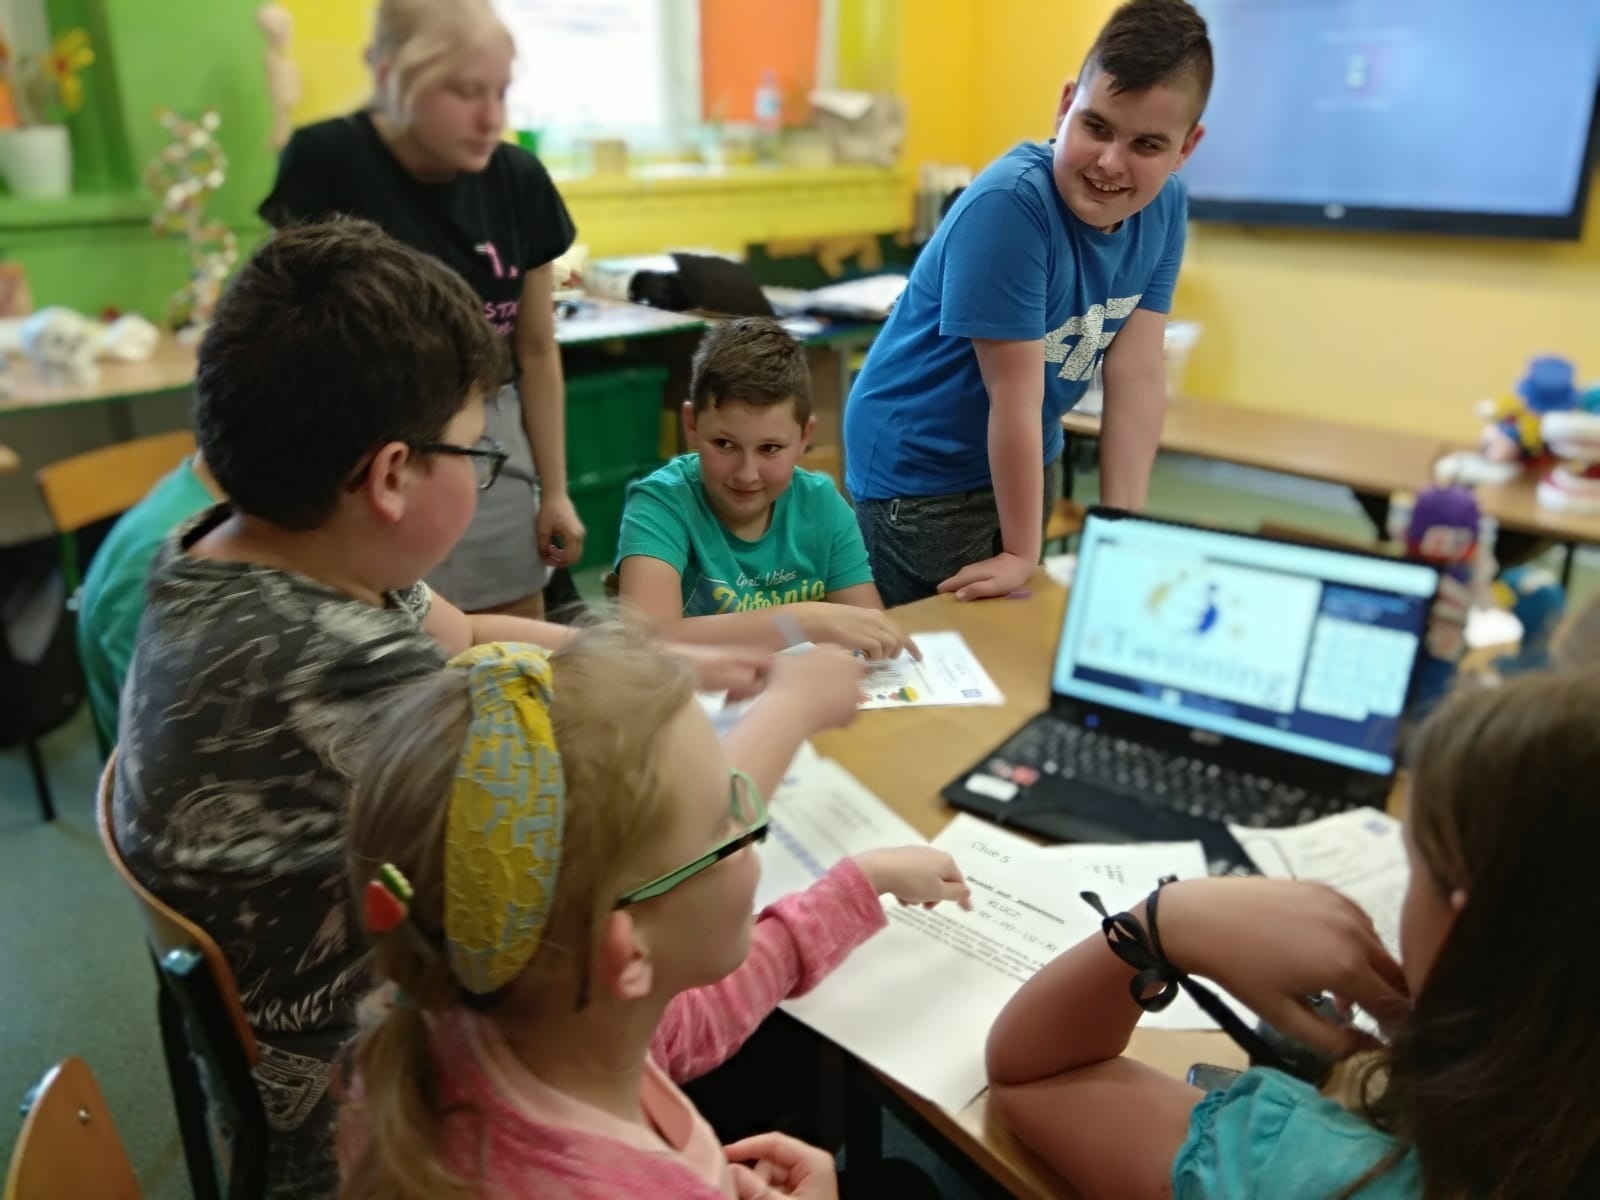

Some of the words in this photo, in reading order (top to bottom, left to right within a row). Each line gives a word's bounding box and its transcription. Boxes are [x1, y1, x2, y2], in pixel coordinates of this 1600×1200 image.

[765, 568, 797, 587] Vibes
[971, 840, 1000, 859] Clue
[1000, 854, 1011, 865] 5
